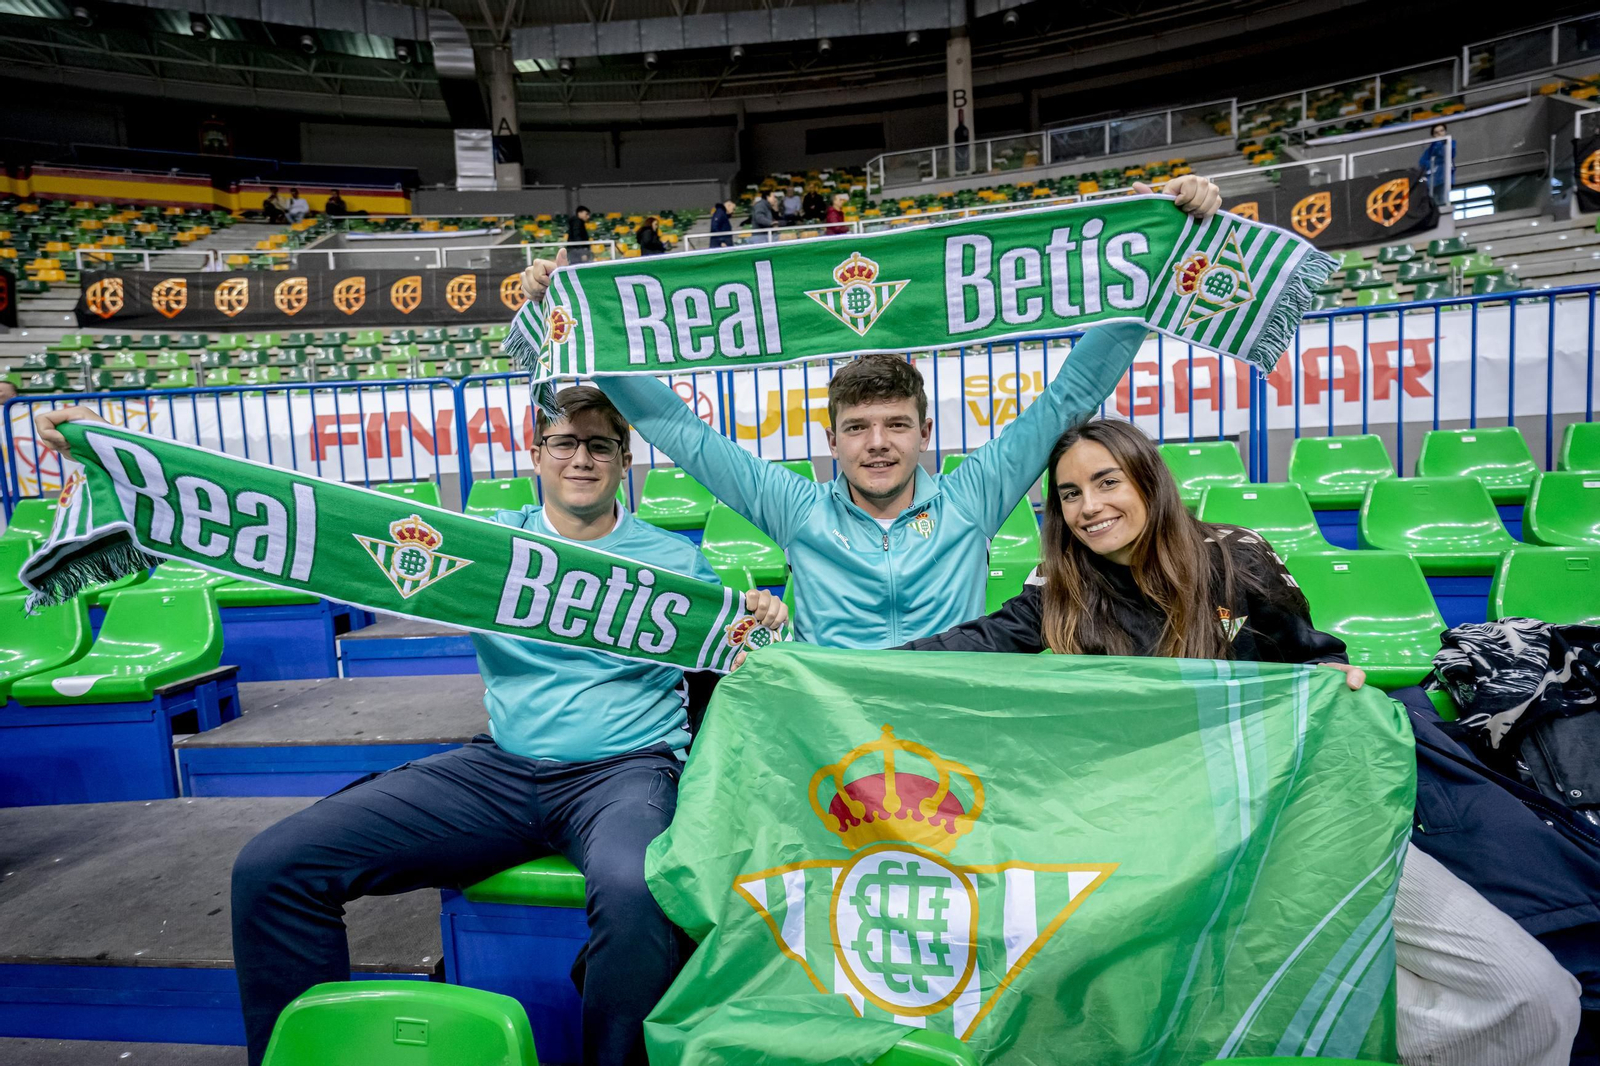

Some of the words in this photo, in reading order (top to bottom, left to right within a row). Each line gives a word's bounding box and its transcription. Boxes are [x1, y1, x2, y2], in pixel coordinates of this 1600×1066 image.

[952, 89, 968, 108] B
[497, 117, 514, 135] A
[614, 259, 783, 365] Real
[945, 217, 1149, 335] Betis
[967, 396, 1038, 427] VA
[85, 431, 317, 582] Real
[494, 536, 691, 653] Betis
